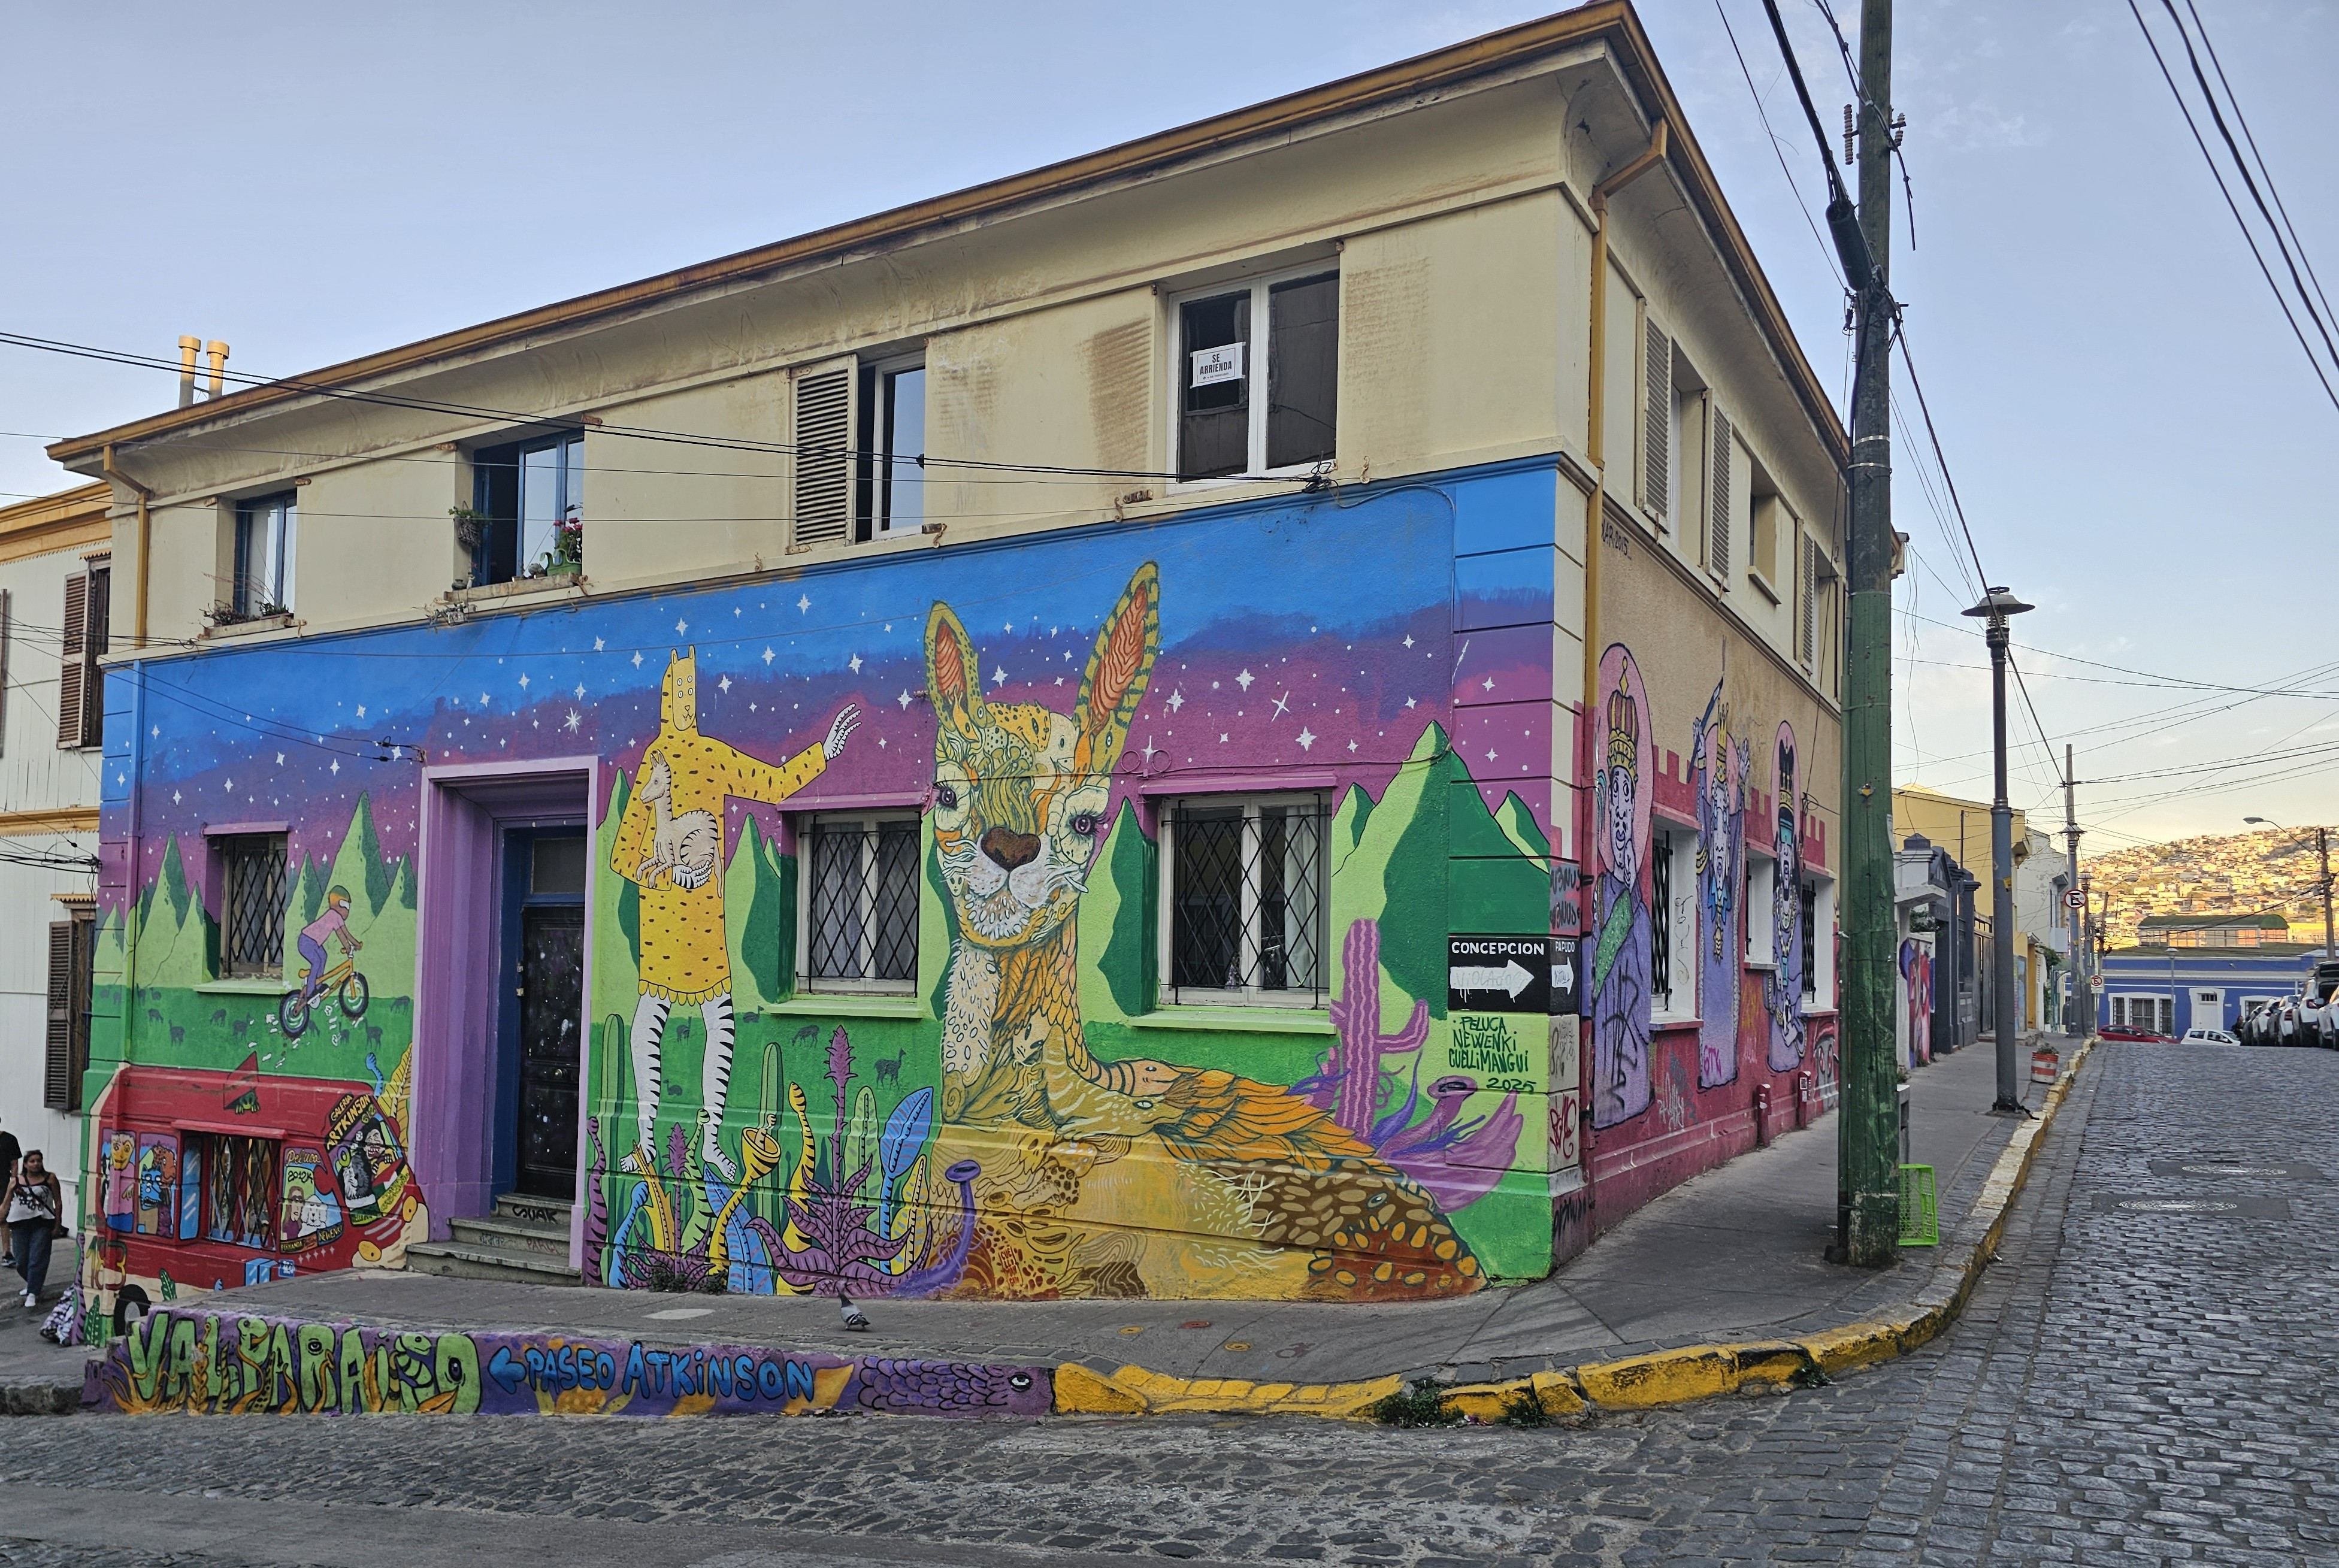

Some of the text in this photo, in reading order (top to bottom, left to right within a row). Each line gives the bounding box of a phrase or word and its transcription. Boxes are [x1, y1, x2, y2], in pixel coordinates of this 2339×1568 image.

[1212, 353, 1220, 363] SE
[1200, 361, 1232, 375] ARRIENDA
[1451, 942, 1544, 955] CONCEPCION
[1555, 940, 1575, 953] PAPUDO
[1460, 1016, 1507, 1035] PELUCA
[1486, 1077, 1537, 1094] 2025
[326, 1094, 376, 1151] ARTKINSON 612
[525, 1345, 616, 1393] PASEO
